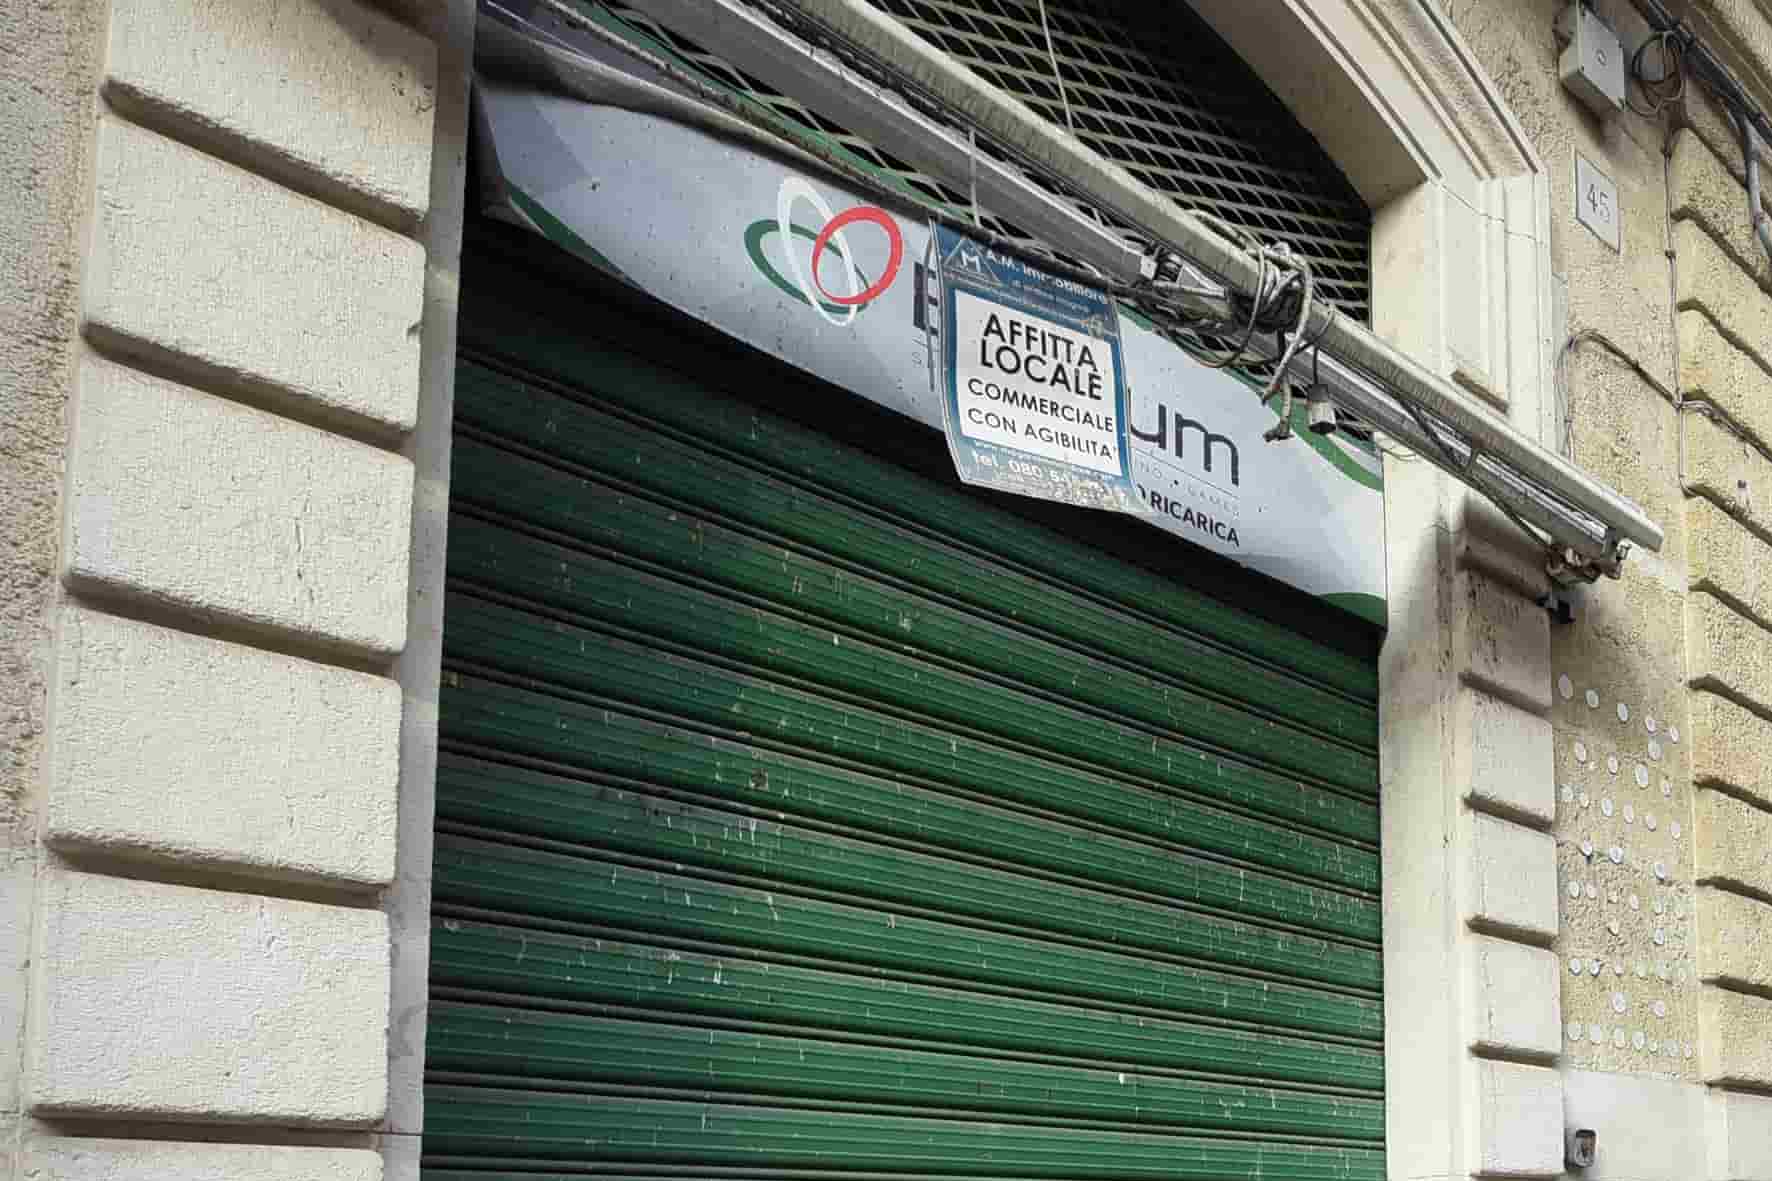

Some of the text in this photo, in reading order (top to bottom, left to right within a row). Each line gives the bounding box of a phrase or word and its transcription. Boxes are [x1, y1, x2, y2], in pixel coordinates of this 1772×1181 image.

[1586, 184, 1610, 224] 45
[980, 338, 1103, 401] LOCALE
[983, 312, 1098, 373] AFFITTA
[967, 378, 1114, 433] COMMERCIALE
[967, 407, 1017, 434] CON
[1150, 490, 1240, 547] RICARICA
